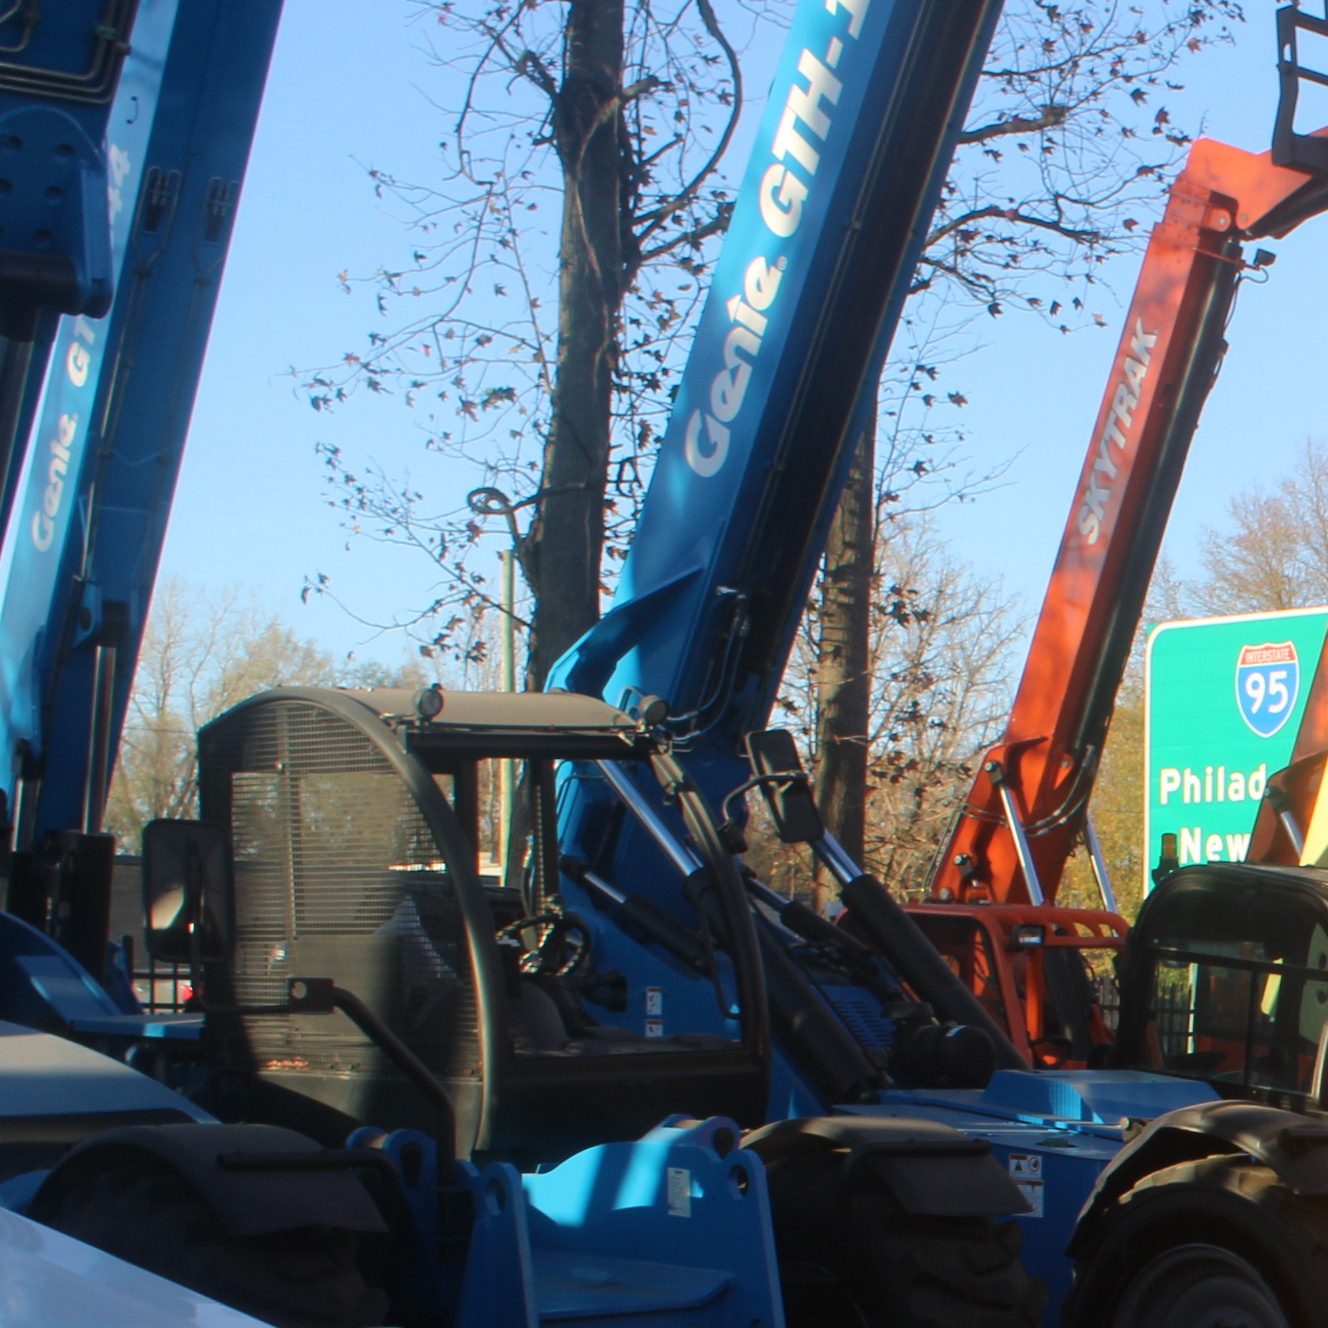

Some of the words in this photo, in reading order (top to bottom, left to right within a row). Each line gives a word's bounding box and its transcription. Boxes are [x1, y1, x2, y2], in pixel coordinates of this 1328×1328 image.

[685, 255, 783, 478] Genie
[1077, 316, 1158, 546] SKYTRAK
[31, 410, 78, 552] Genie
[1245, 650, 1291, 664] INTERSTATE
[1245, 671, 1289, 714] 95
[1160, 764, 1267, 805] Philad
[1179, 827, 1251, 864] New
